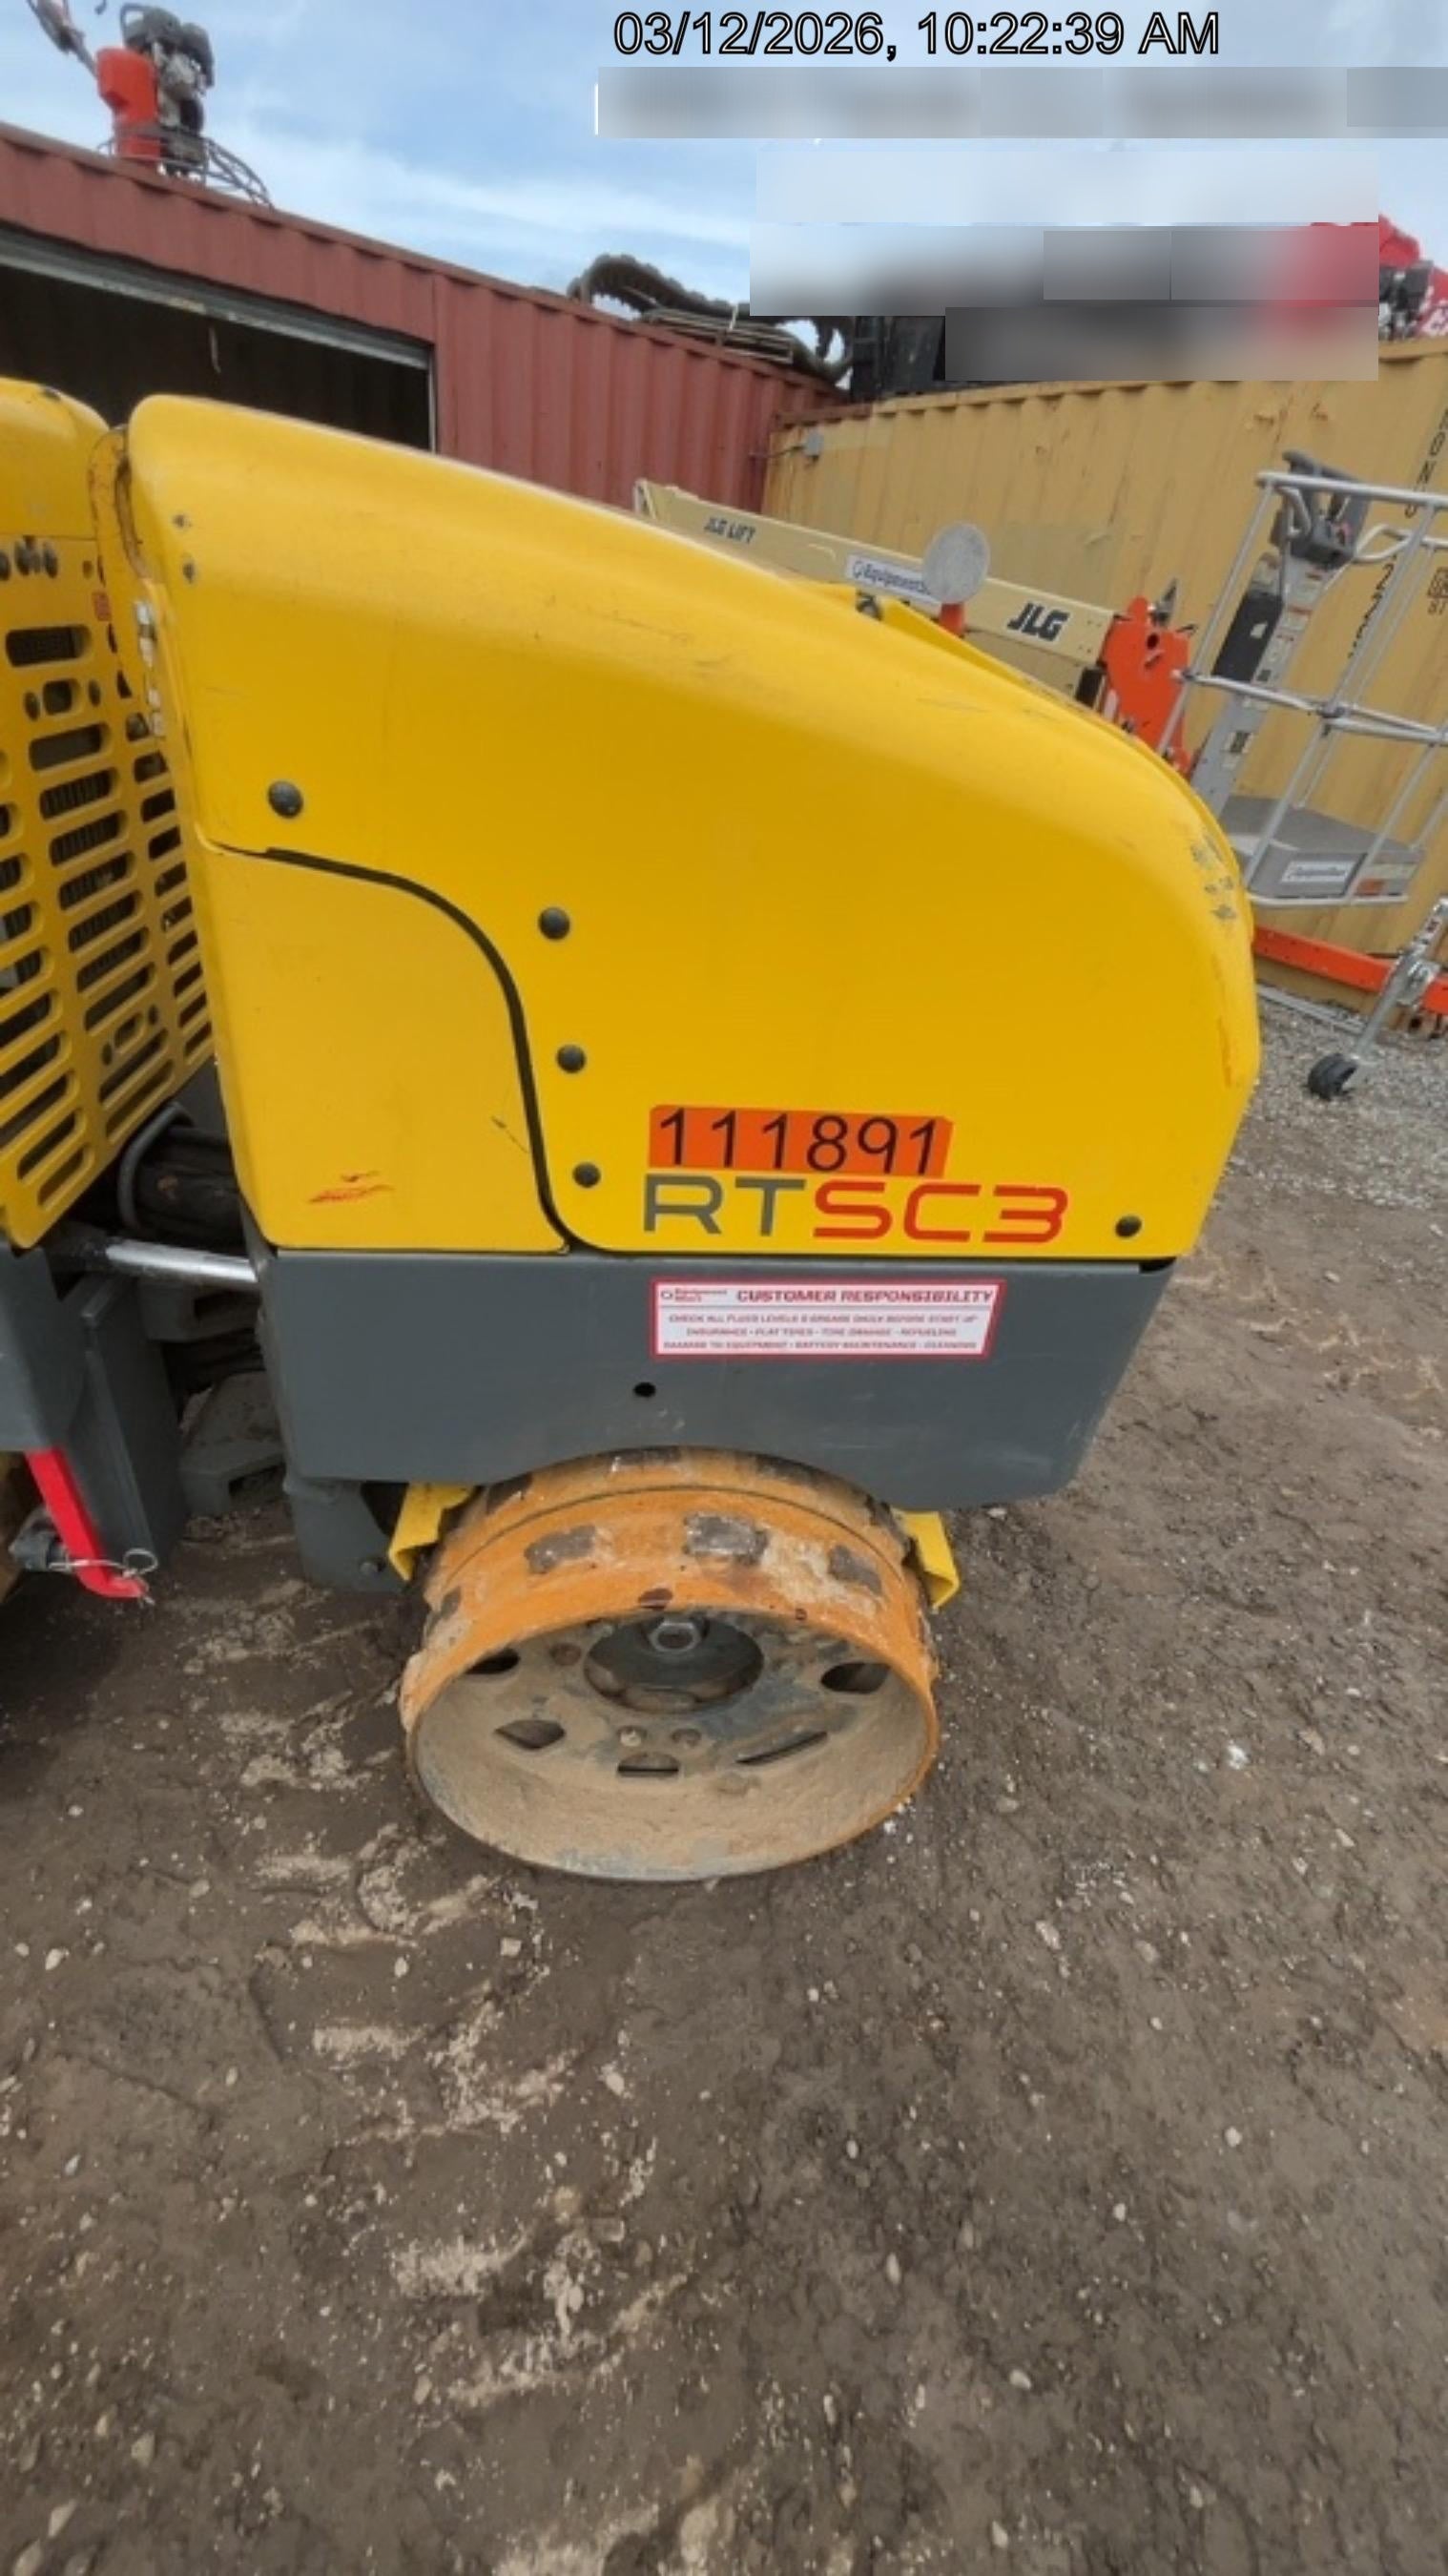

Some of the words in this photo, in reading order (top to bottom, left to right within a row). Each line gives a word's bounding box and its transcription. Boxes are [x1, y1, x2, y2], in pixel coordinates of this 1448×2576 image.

[1006, 602, 1070, 641] JLG
[659, 1108, 937, 1174] 111891
[643, 1174, 1069, 1243] RTSC3
[737, 1290, 837, 1302] CUSTOMER
[840, 1290, 993, 1302] RESPONSIBILITY
